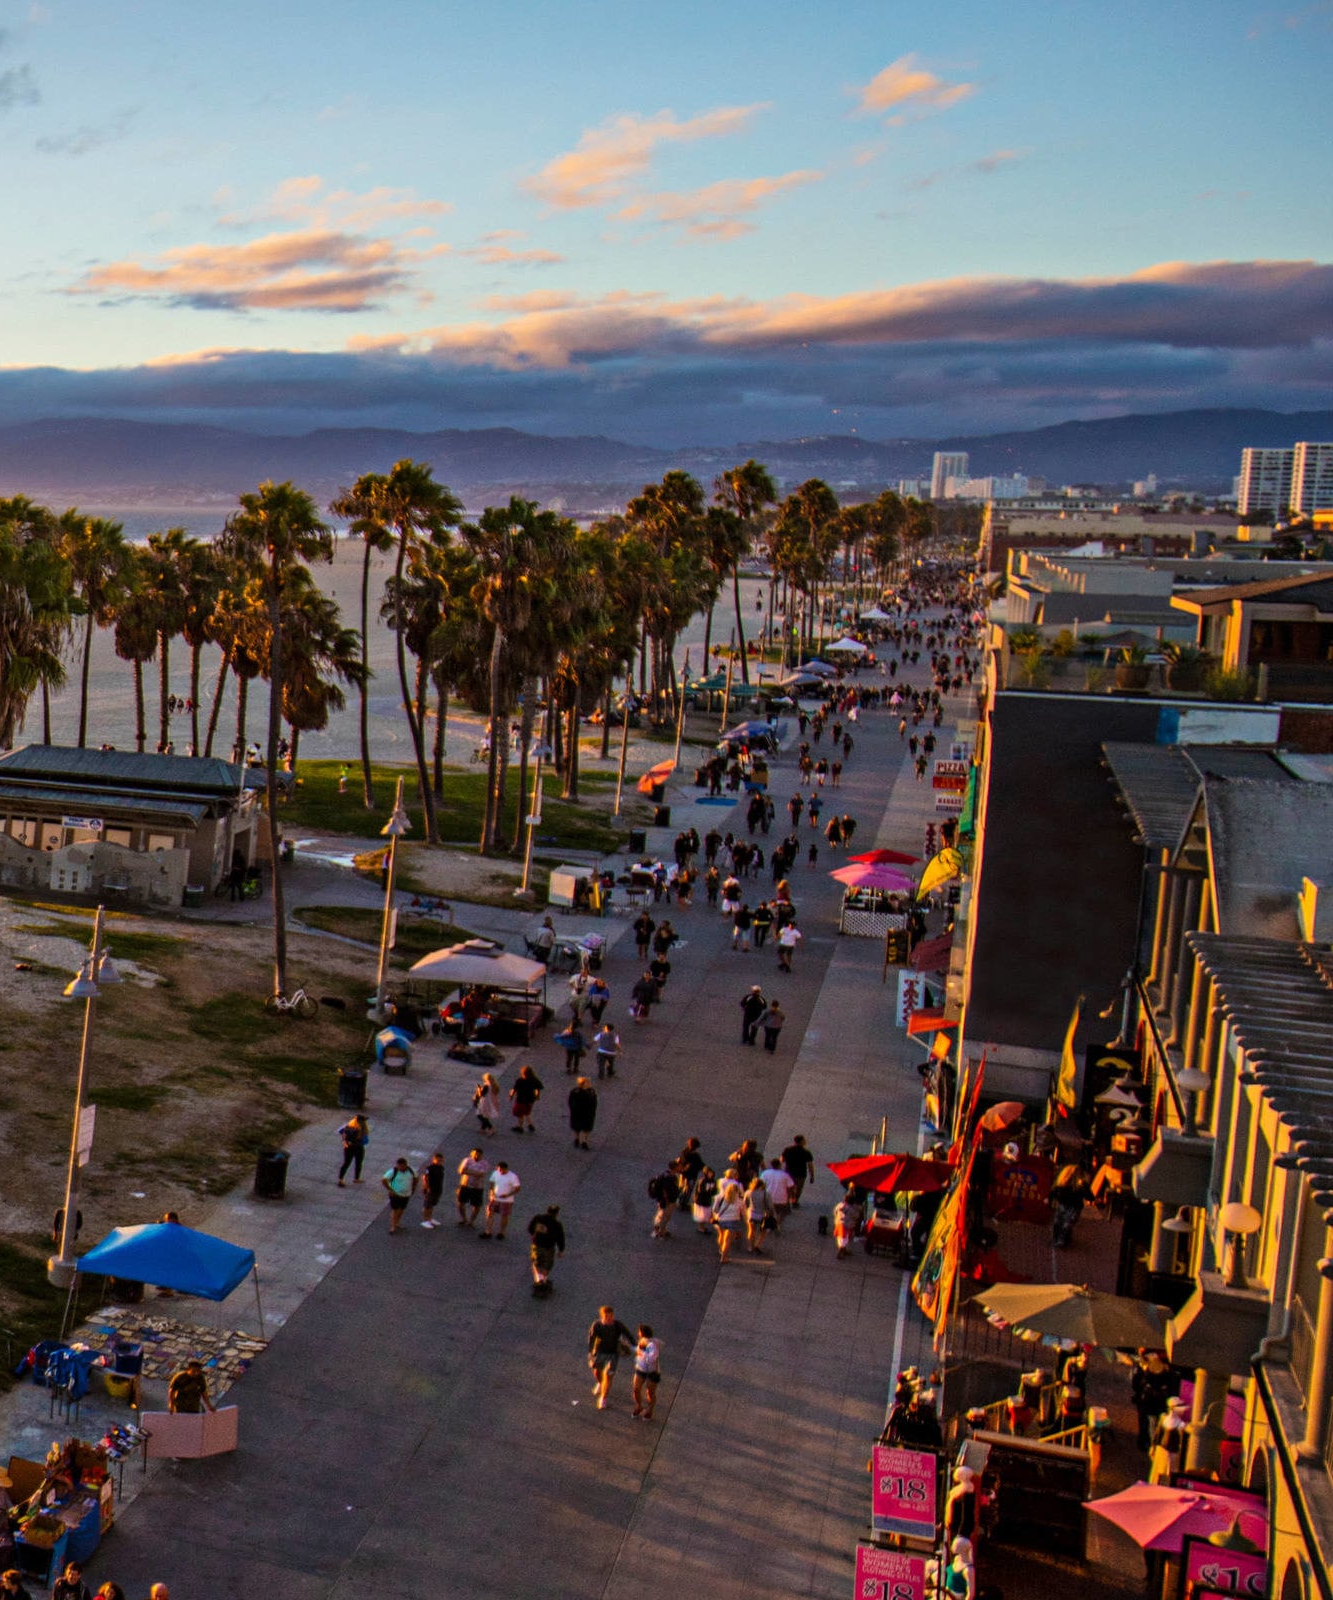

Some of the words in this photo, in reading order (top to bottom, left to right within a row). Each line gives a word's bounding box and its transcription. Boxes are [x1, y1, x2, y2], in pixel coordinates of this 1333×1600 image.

[937, 763, 964, 772] PIZZA
[880, 1475, 927, 1501] $18
[863, 1577, 914, 1600] $18
